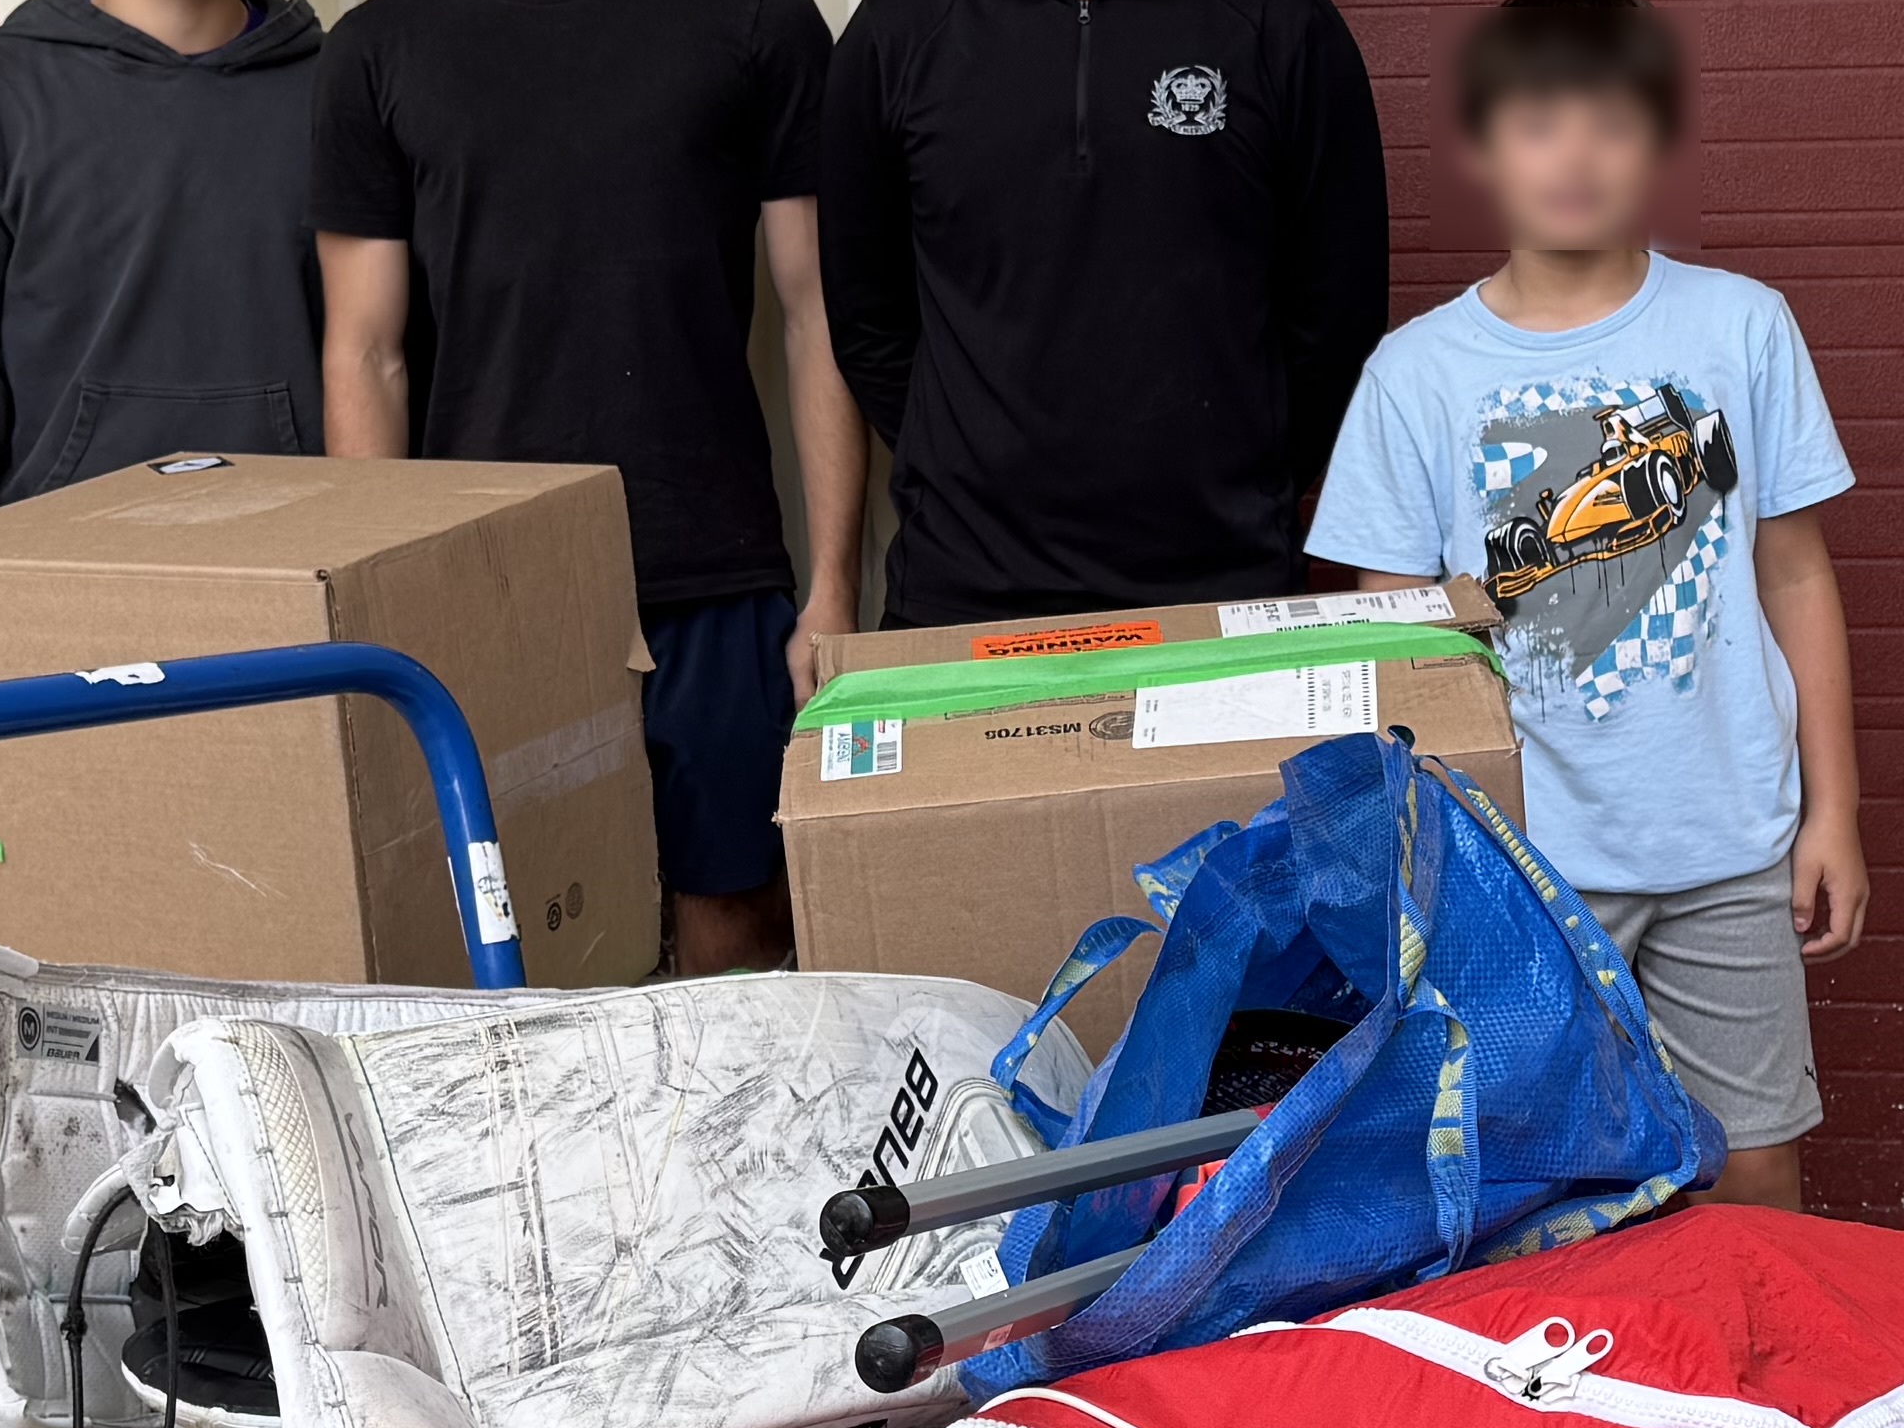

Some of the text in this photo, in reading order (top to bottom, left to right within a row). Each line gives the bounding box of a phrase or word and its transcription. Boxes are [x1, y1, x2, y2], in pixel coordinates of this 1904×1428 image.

[988, 634, 1143, 656] WARNING
[23, 1020, 35, 1036] M
[819, 1047, 939, 1290] BAUR
